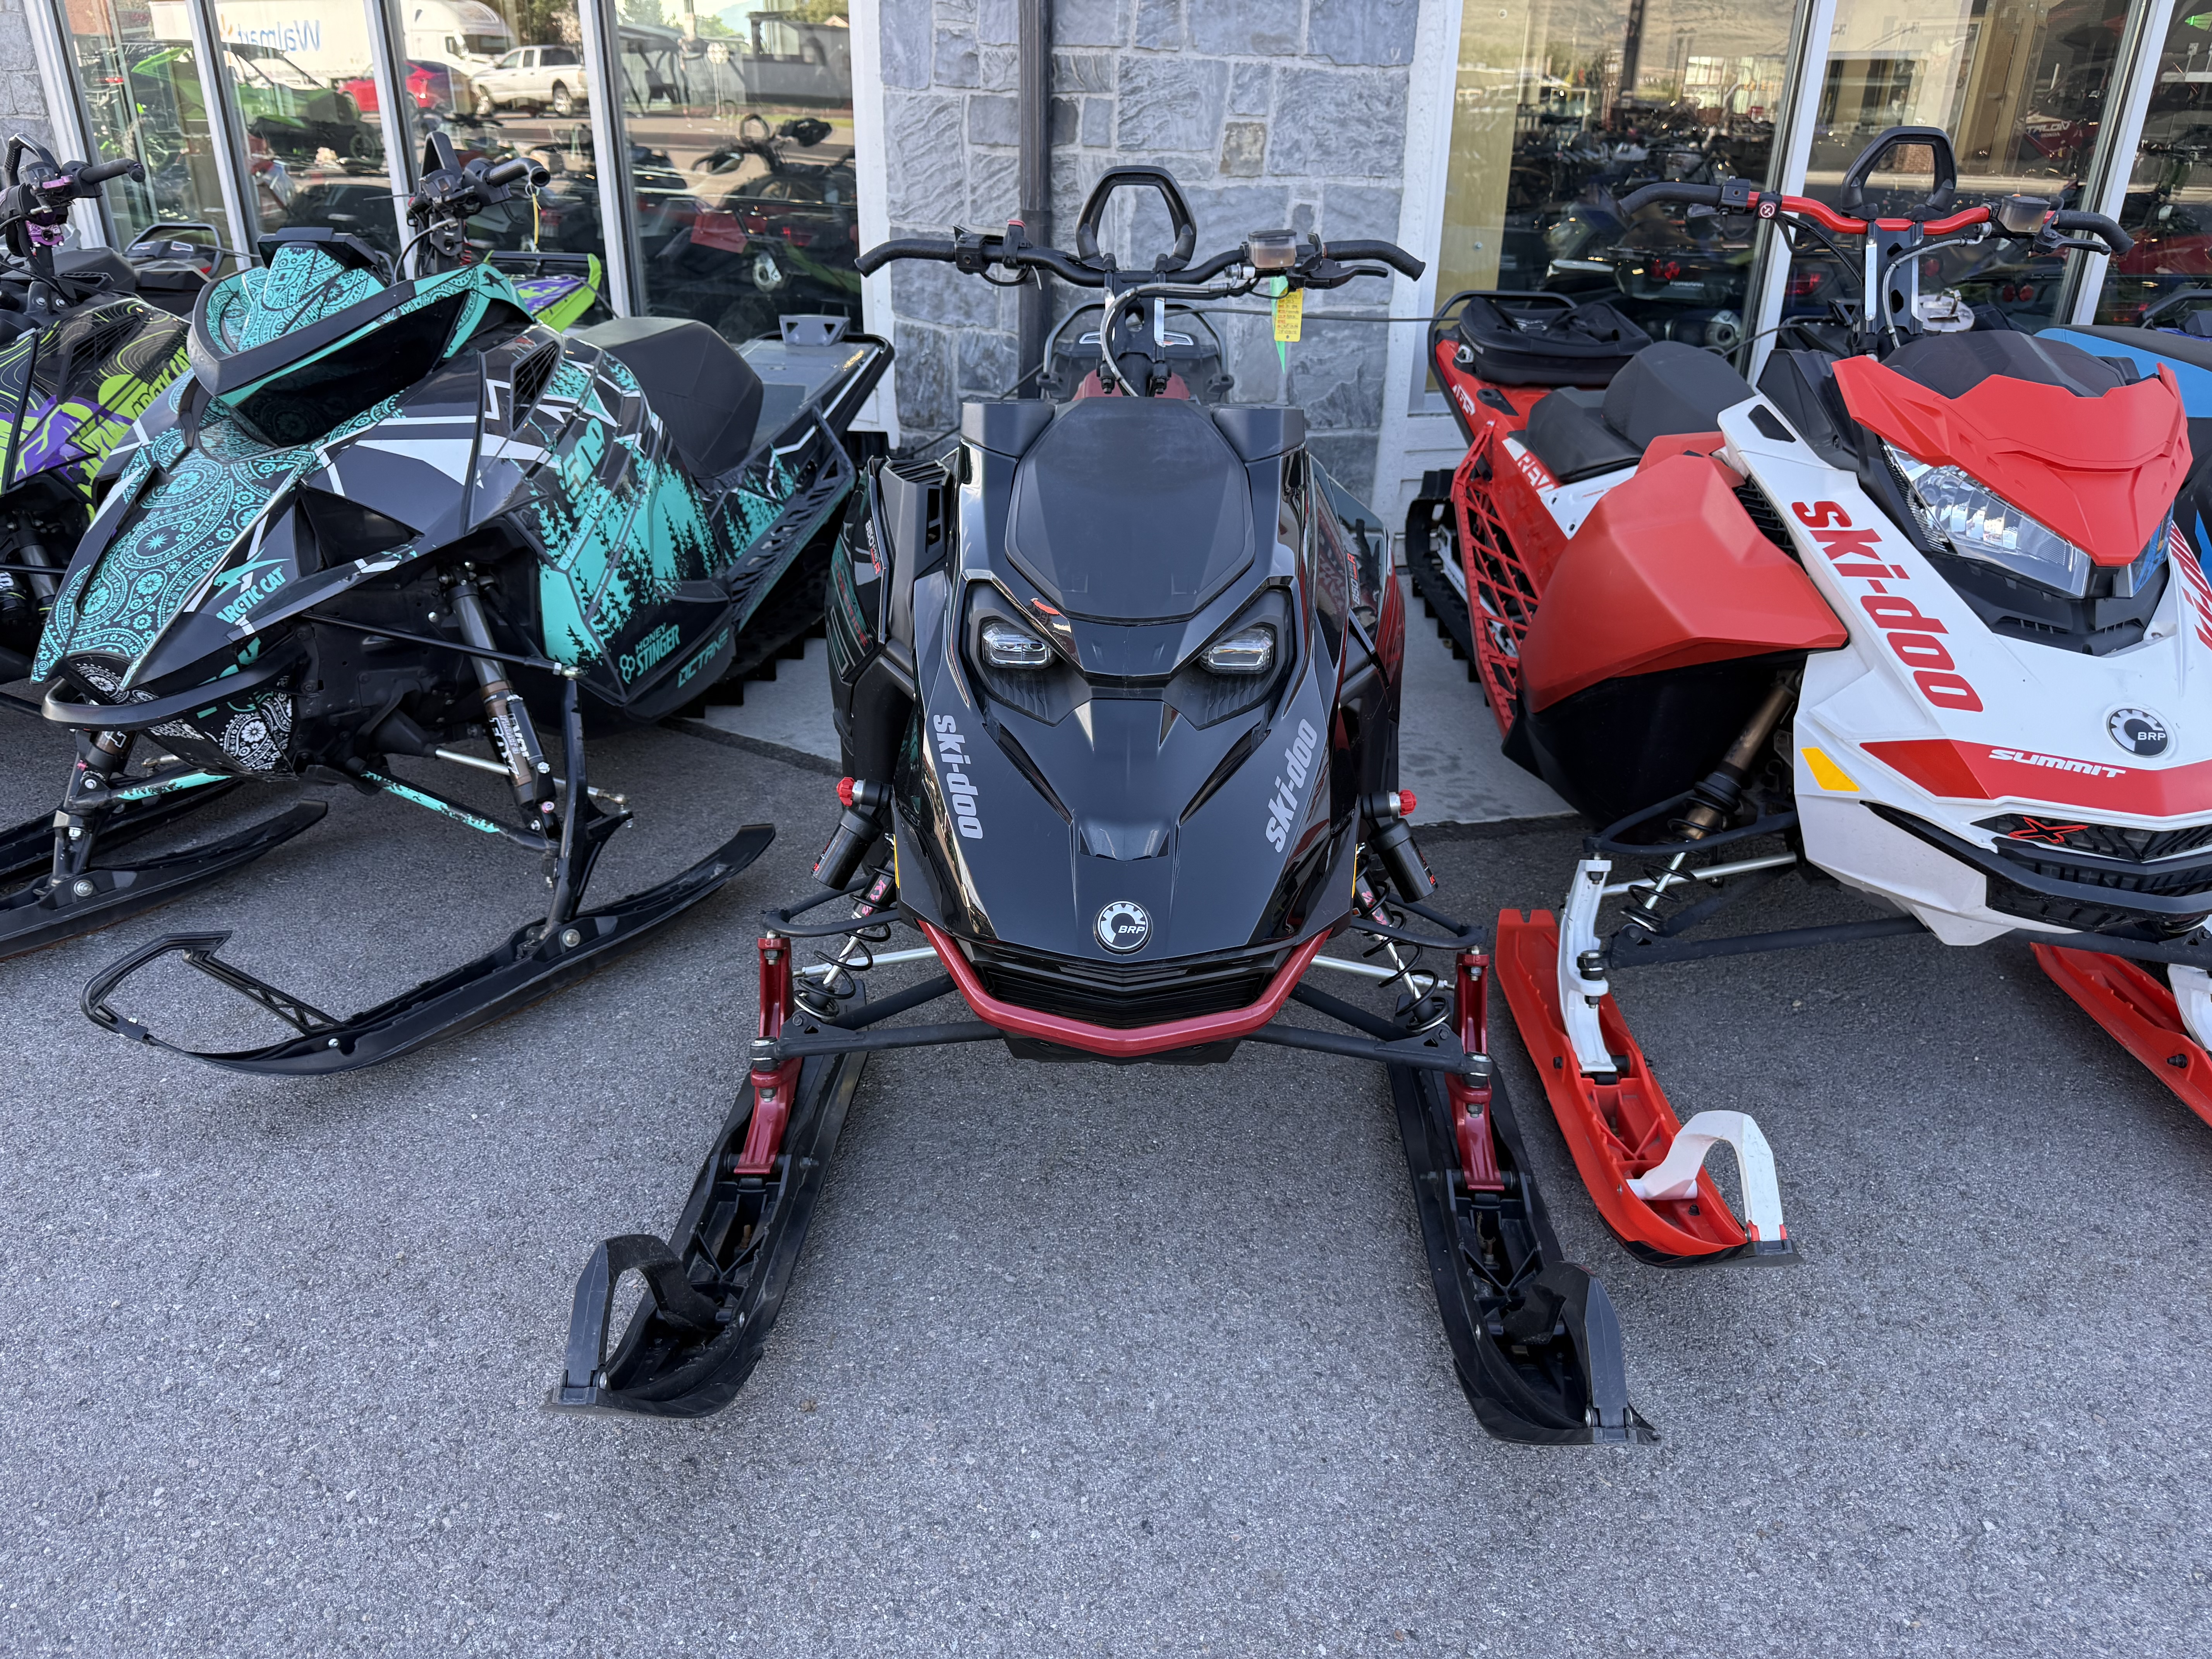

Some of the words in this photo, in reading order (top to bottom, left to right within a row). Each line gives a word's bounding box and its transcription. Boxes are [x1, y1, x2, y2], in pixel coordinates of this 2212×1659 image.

[865, 520, 874, 547] 850
[874, 562, 881, 575] R
[1347, 553, 1356, 565] R
[216, 585, 265, 623] ARCTIC
[259, 567, 287, 593] CAT
[834, 560, 868, 647] FREERIDE
[1350, 577, 1360, 605] 850
[1791, 501, 1984, 712] ski-doo
[635, 622, 666, 654] HONEY
[636, 624, 680, 677] STINGER
[677, 627, 729, 689] OCTANE
[2137, 732, 2166, 741] BRP
[933, 714, 984, 839] ski-doo
[1265, 718, 1318, 853] ski-doo
[1989, 749, 2126, 778] SUMMIT
[1118, 924, 1146, 934] BRP
[1361, 891, 1388, 926] KB
